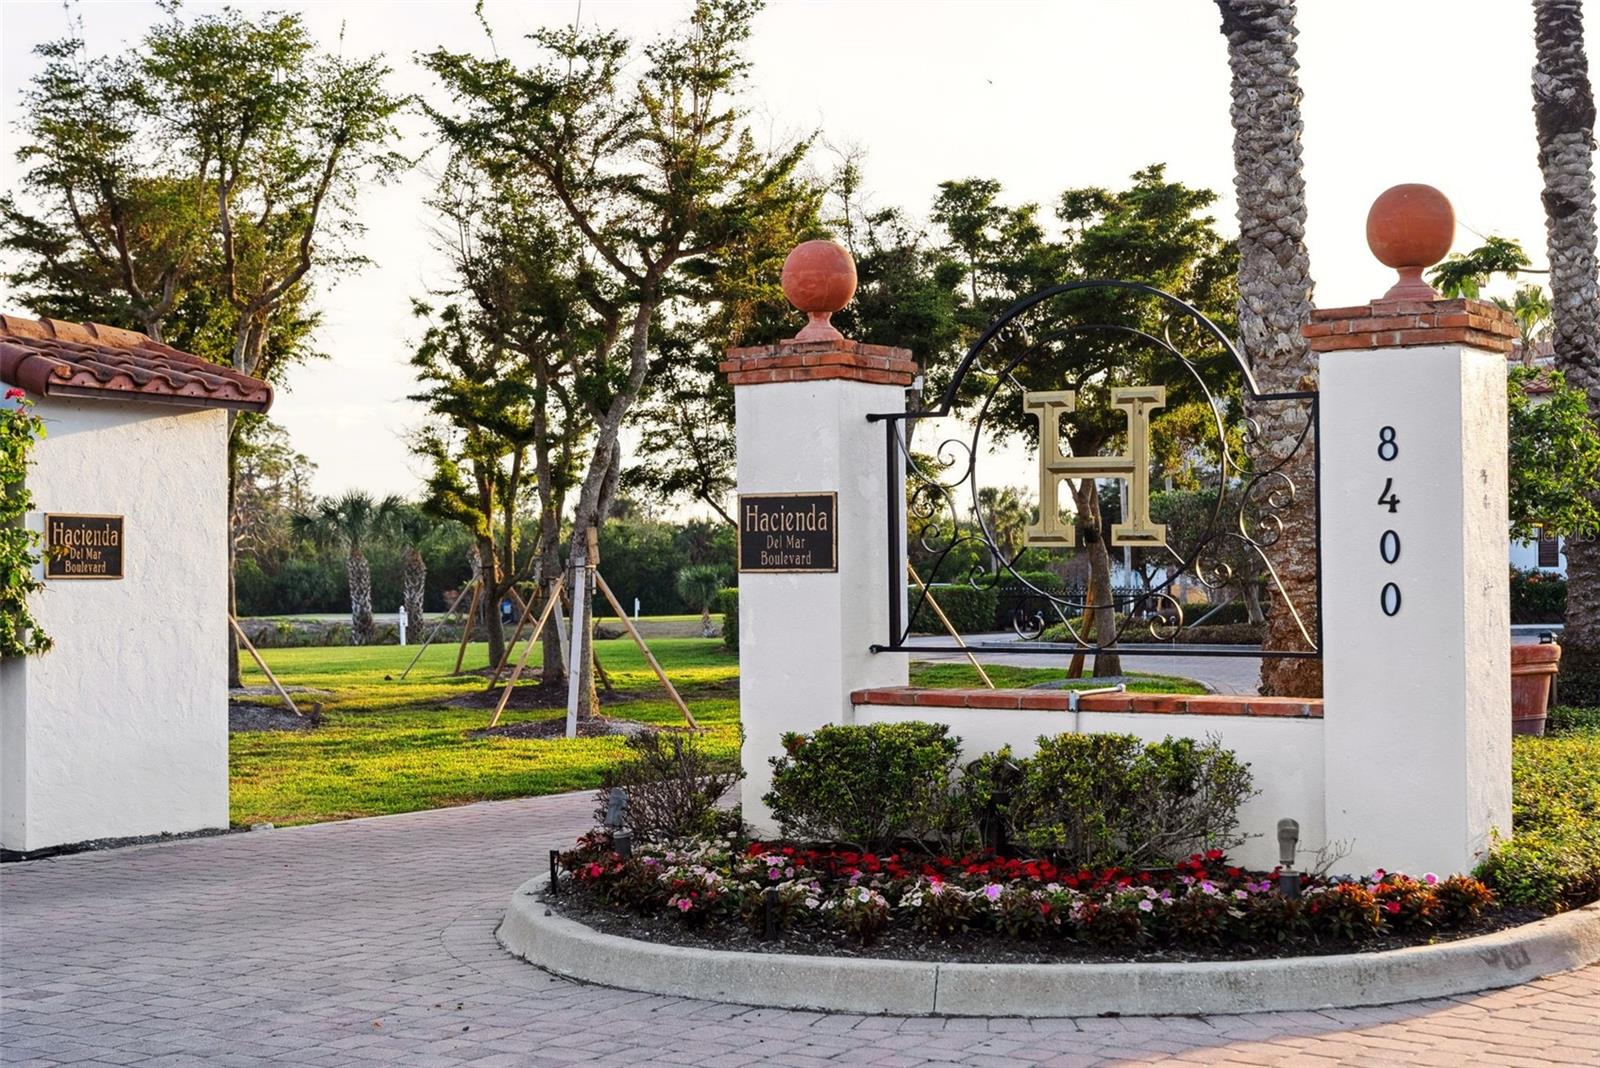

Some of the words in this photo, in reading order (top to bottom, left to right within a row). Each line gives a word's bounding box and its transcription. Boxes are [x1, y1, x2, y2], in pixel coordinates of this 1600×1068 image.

[1023, 385, 1166, 547] H
[746, 503, 827, 532] Hacienda
[1377, 425, 1402, 617] 8400
[53, 522, 118, 546] Hacienda
[766, 534, 782, 549] Del
[786, 534, 805, 549] Mar
[70, 547, 83, 560] Del
[86, 547, 102, 560] Mar
[761, 550, 811, 565] Boulevard
[65, 560, 106, 573] Boulevard
